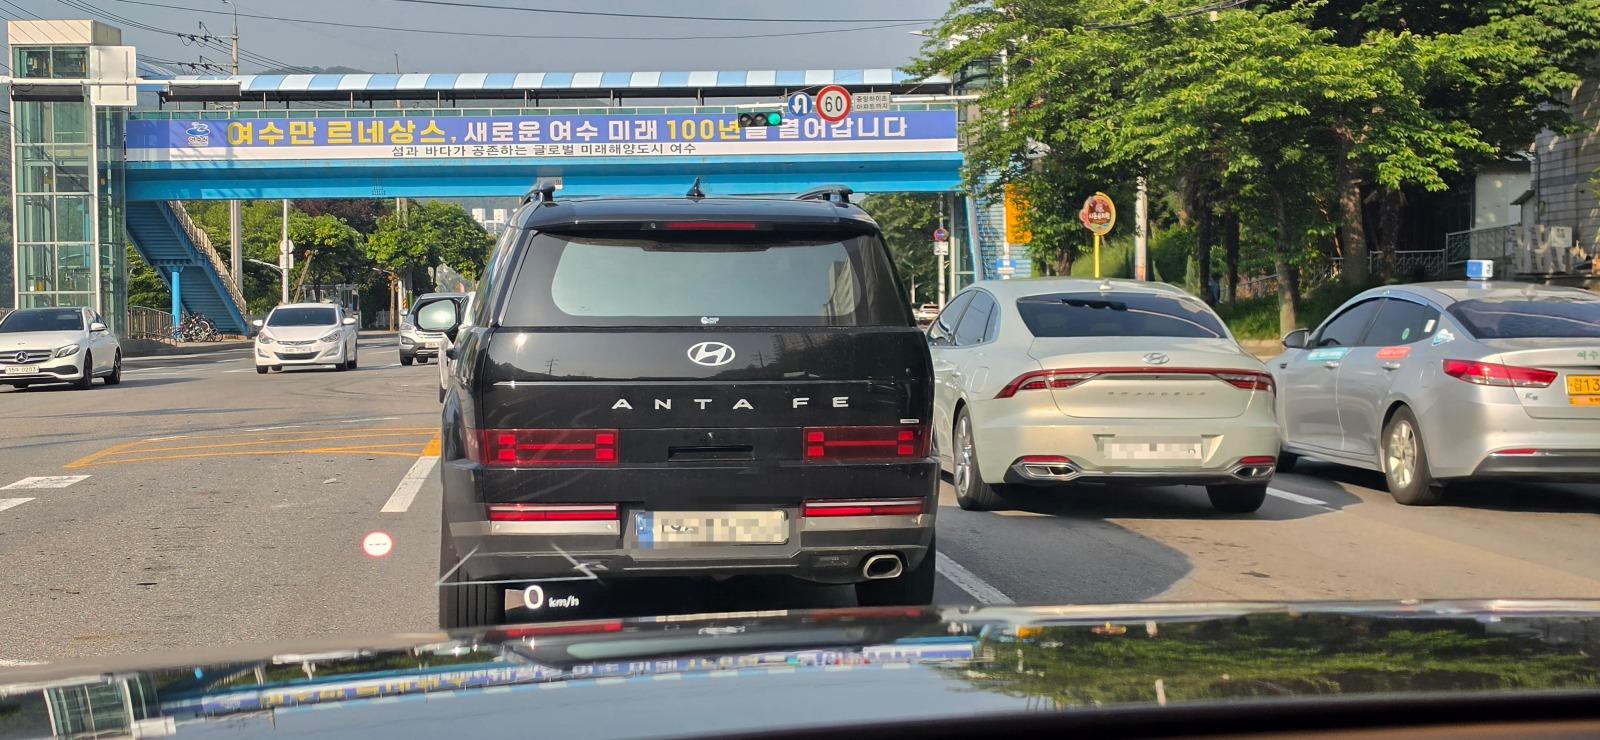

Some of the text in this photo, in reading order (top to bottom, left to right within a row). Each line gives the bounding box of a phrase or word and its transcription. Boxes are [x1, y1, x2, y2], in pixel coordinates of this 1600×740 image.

[825, 96, 843, 112] 60
[228, 120, 317, 145] 여수만
[327, 120, 457, 144] 르네상스,
[464, 120, 541, 142] 새로운
[549, 120, 598, 142] 여수
[608, 119, 658, 141] 미래
[392, 143, 697, 157] 섬과 바다가 공존하는 글로벌 미래해양도시 여수
[611, 396, 849, 410] ANTA FE
[523, 584, 580, 610] 0 km/h
